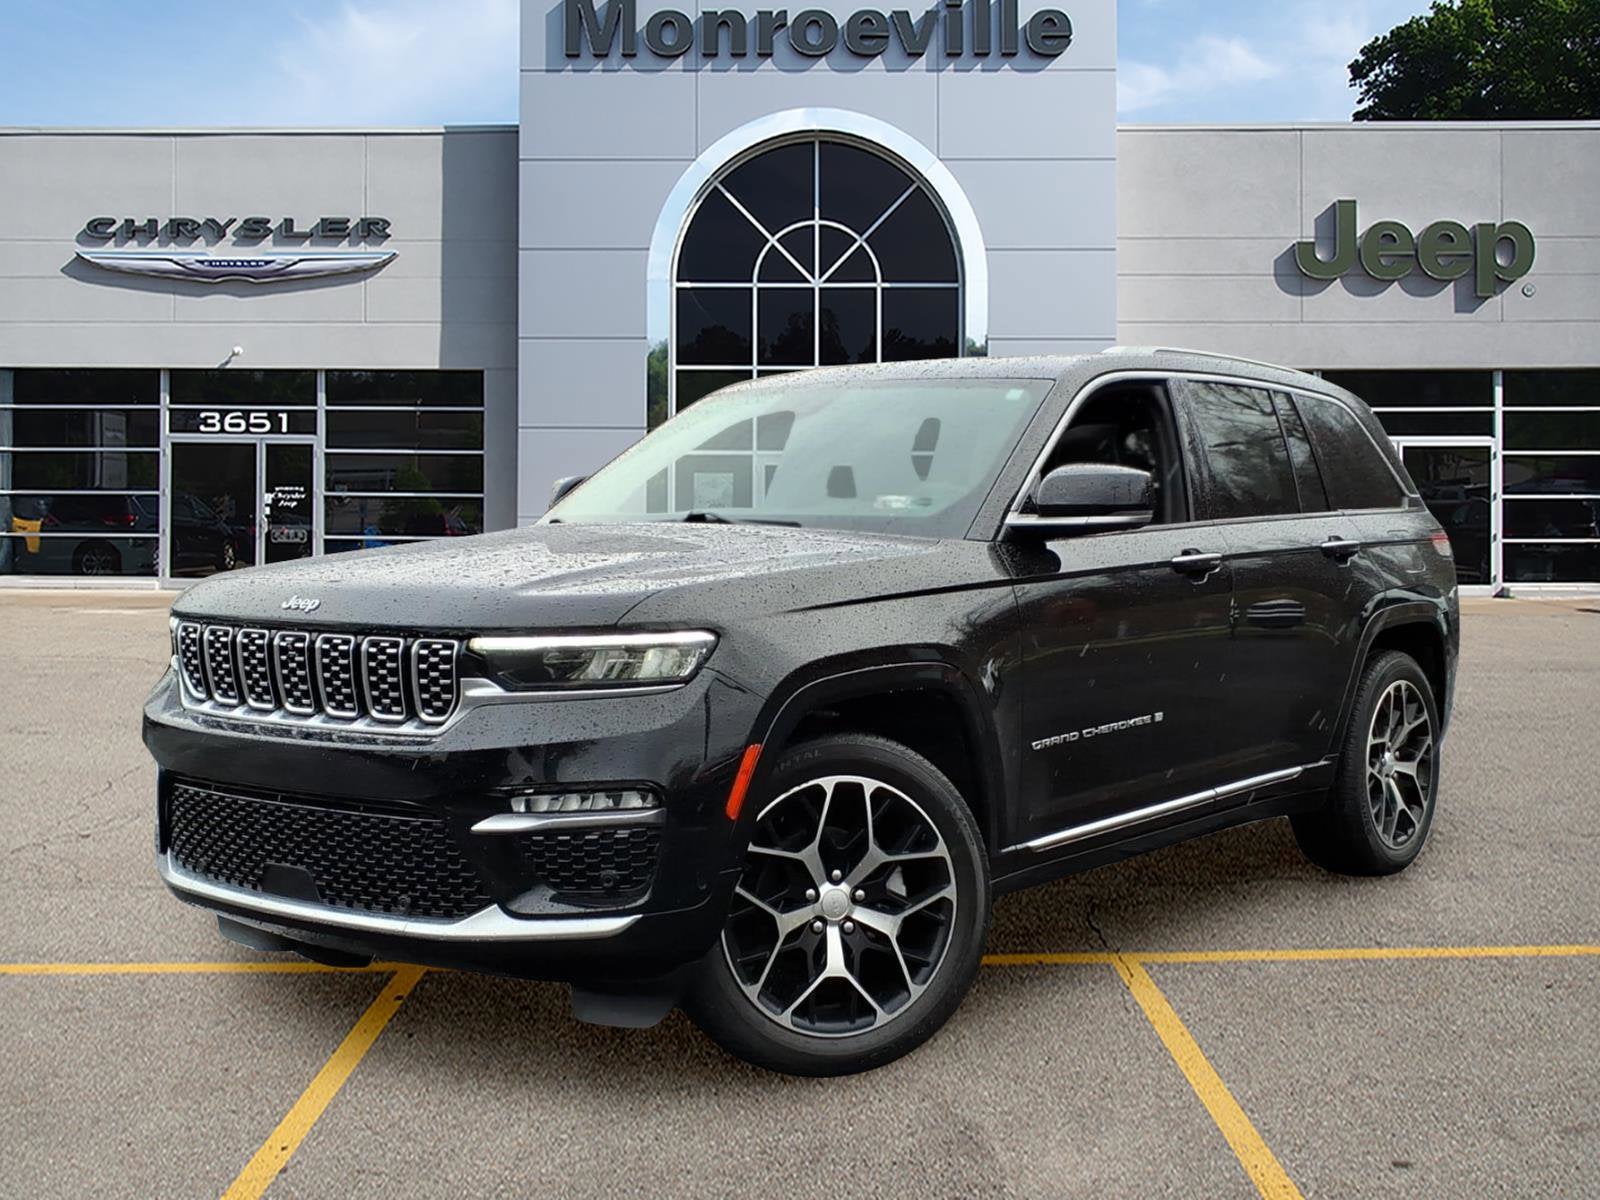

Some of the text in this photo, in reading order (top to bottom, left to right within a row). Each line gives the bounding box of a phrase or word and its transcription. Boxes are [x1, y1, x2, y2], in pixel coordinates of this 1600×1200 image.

[565, 0, 1073, 57] Monroeville
[86, 217, 392, 239] CHRYSLER
[1295, 199, 1536, 297] Jeep
[199, 411, 288, 433] 3651
[281, 595, 321, 613] Jeep
[1031, 714, 1152, 750] GRAND CHEROKEE
